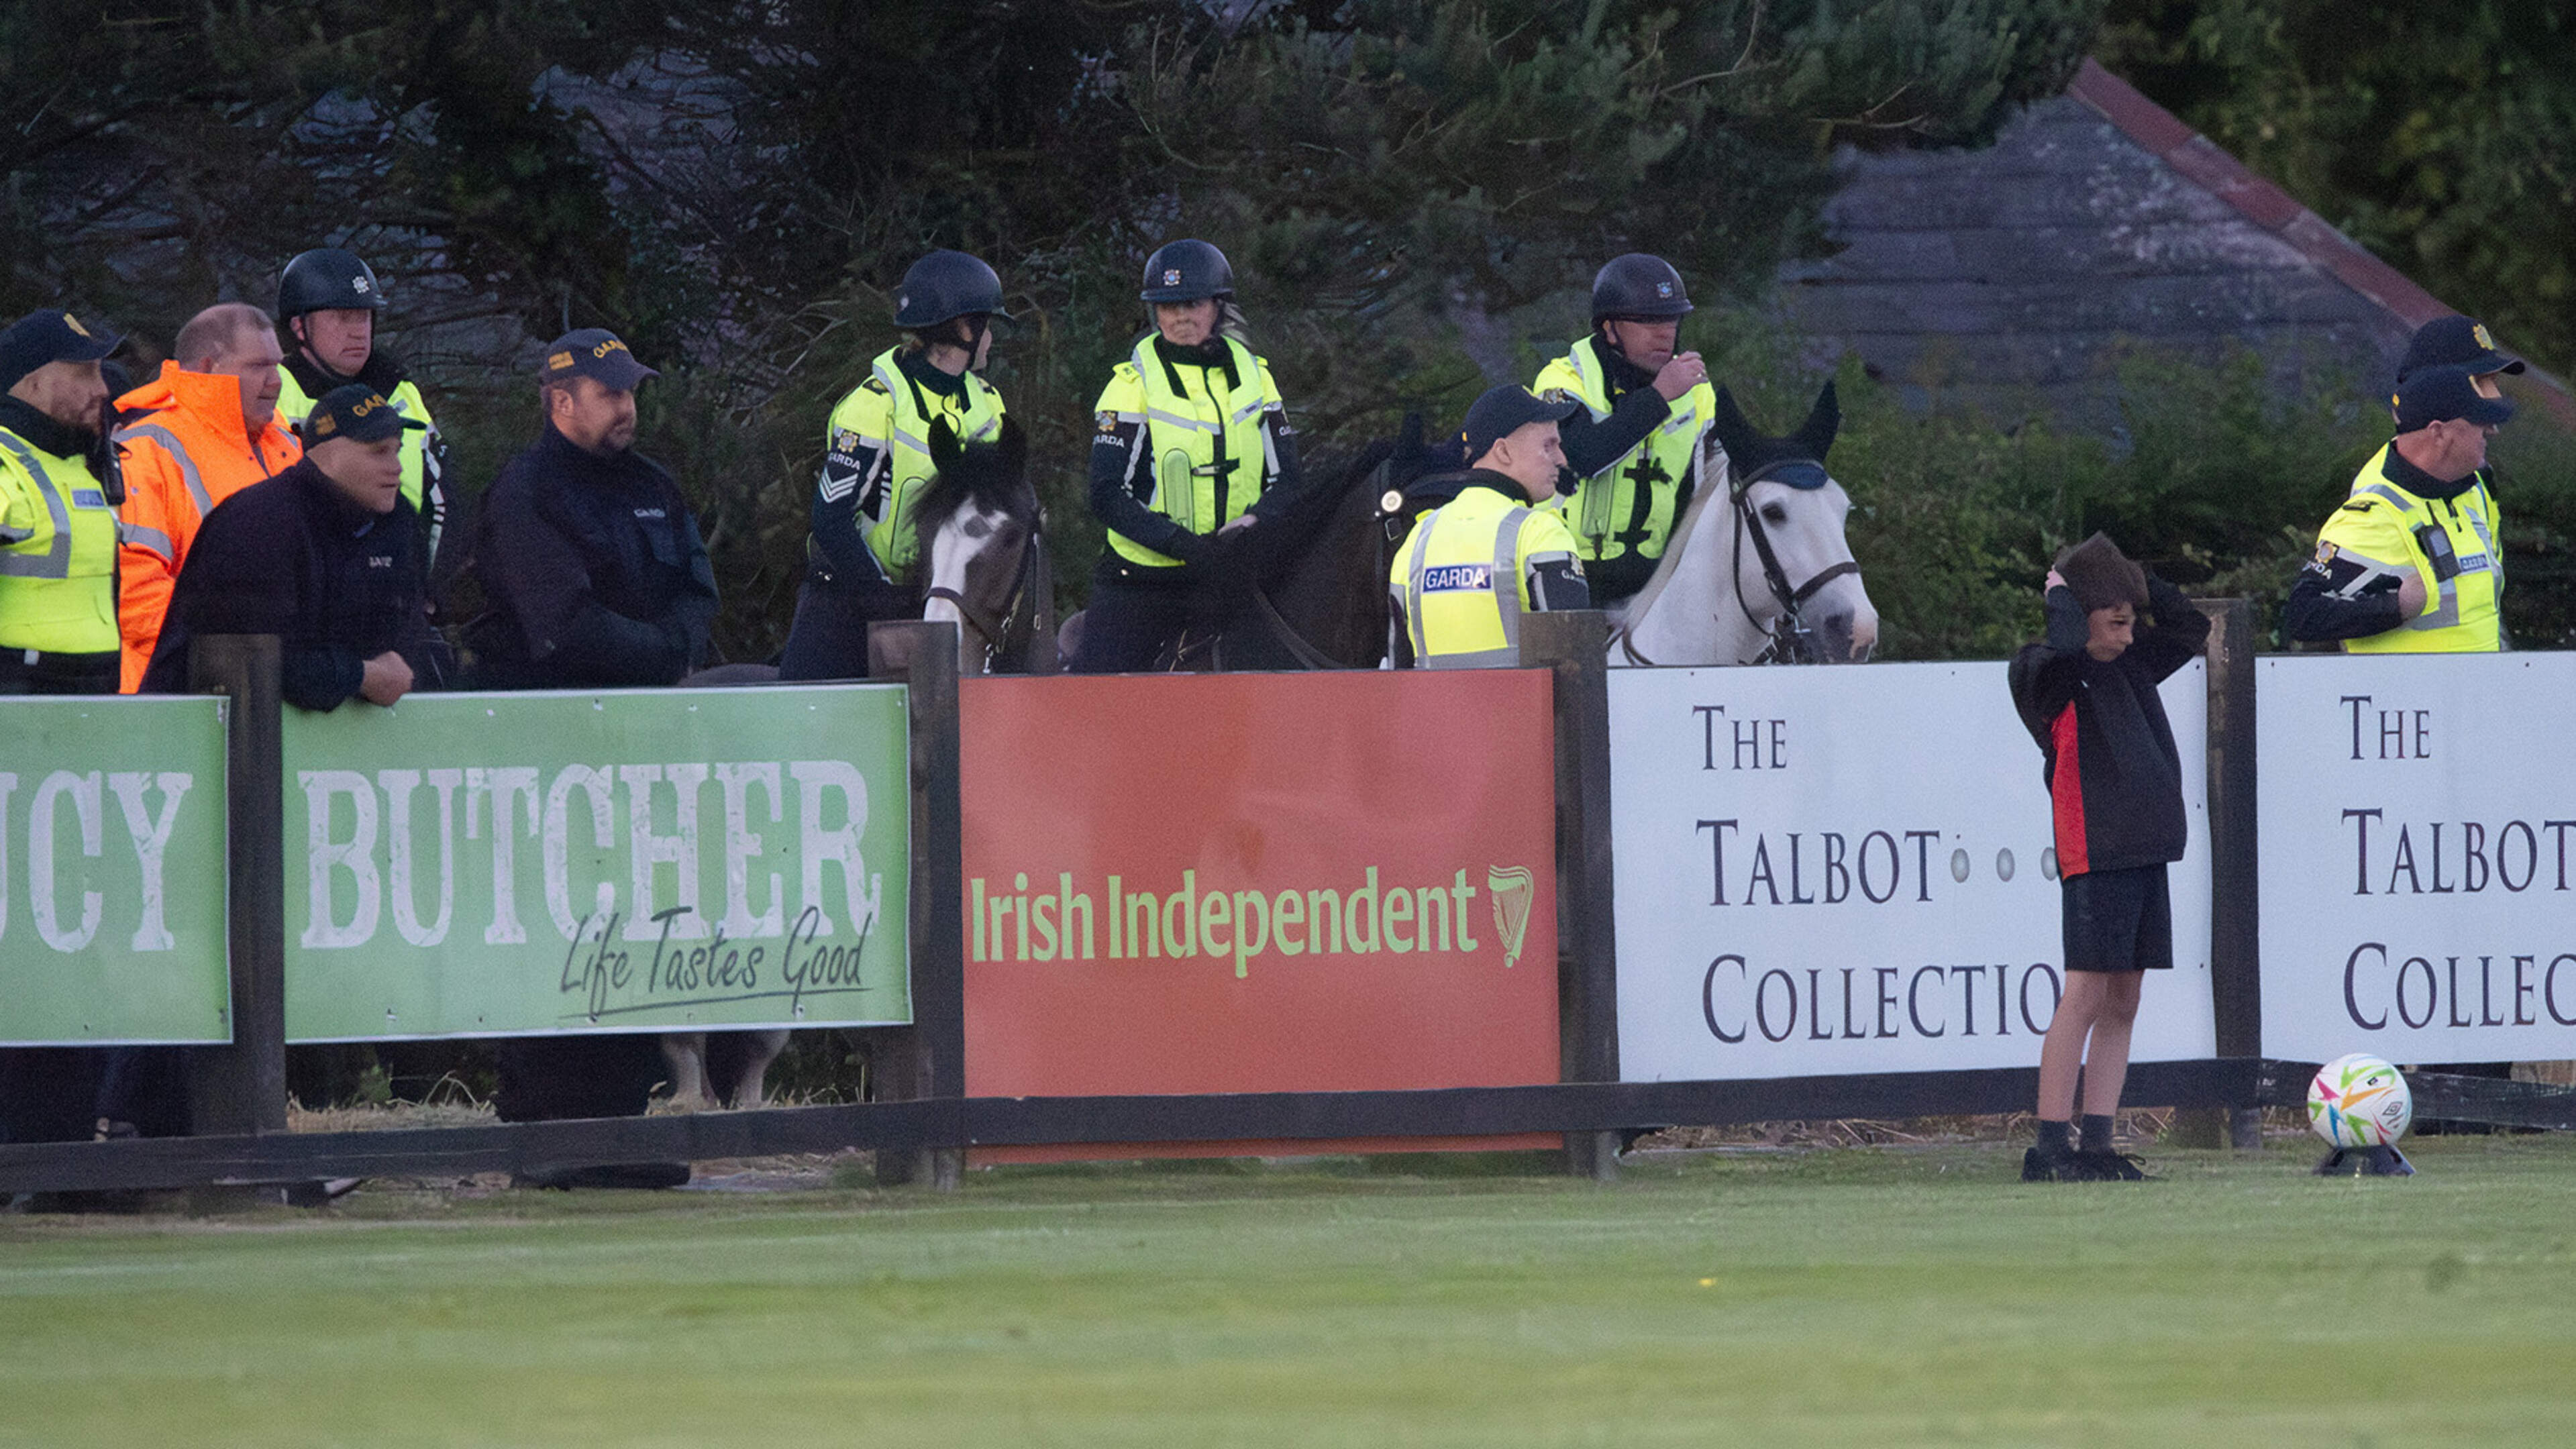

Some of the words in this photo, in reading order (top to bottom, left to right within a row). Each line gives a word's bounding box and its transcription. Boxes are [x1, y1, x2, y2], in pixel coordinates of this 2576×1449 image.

[1425, 567, 1488, 589] GARDA
[297, 760, 881, 949] BUTCHER
[560, 912, 633, 1022] Life
[650, 906, 764, 993] Tastes
[782, 906, 872, 1014] Good
[971, 871, 1094, 962] Irish
[1108, 865, 1478, 979] Independent
